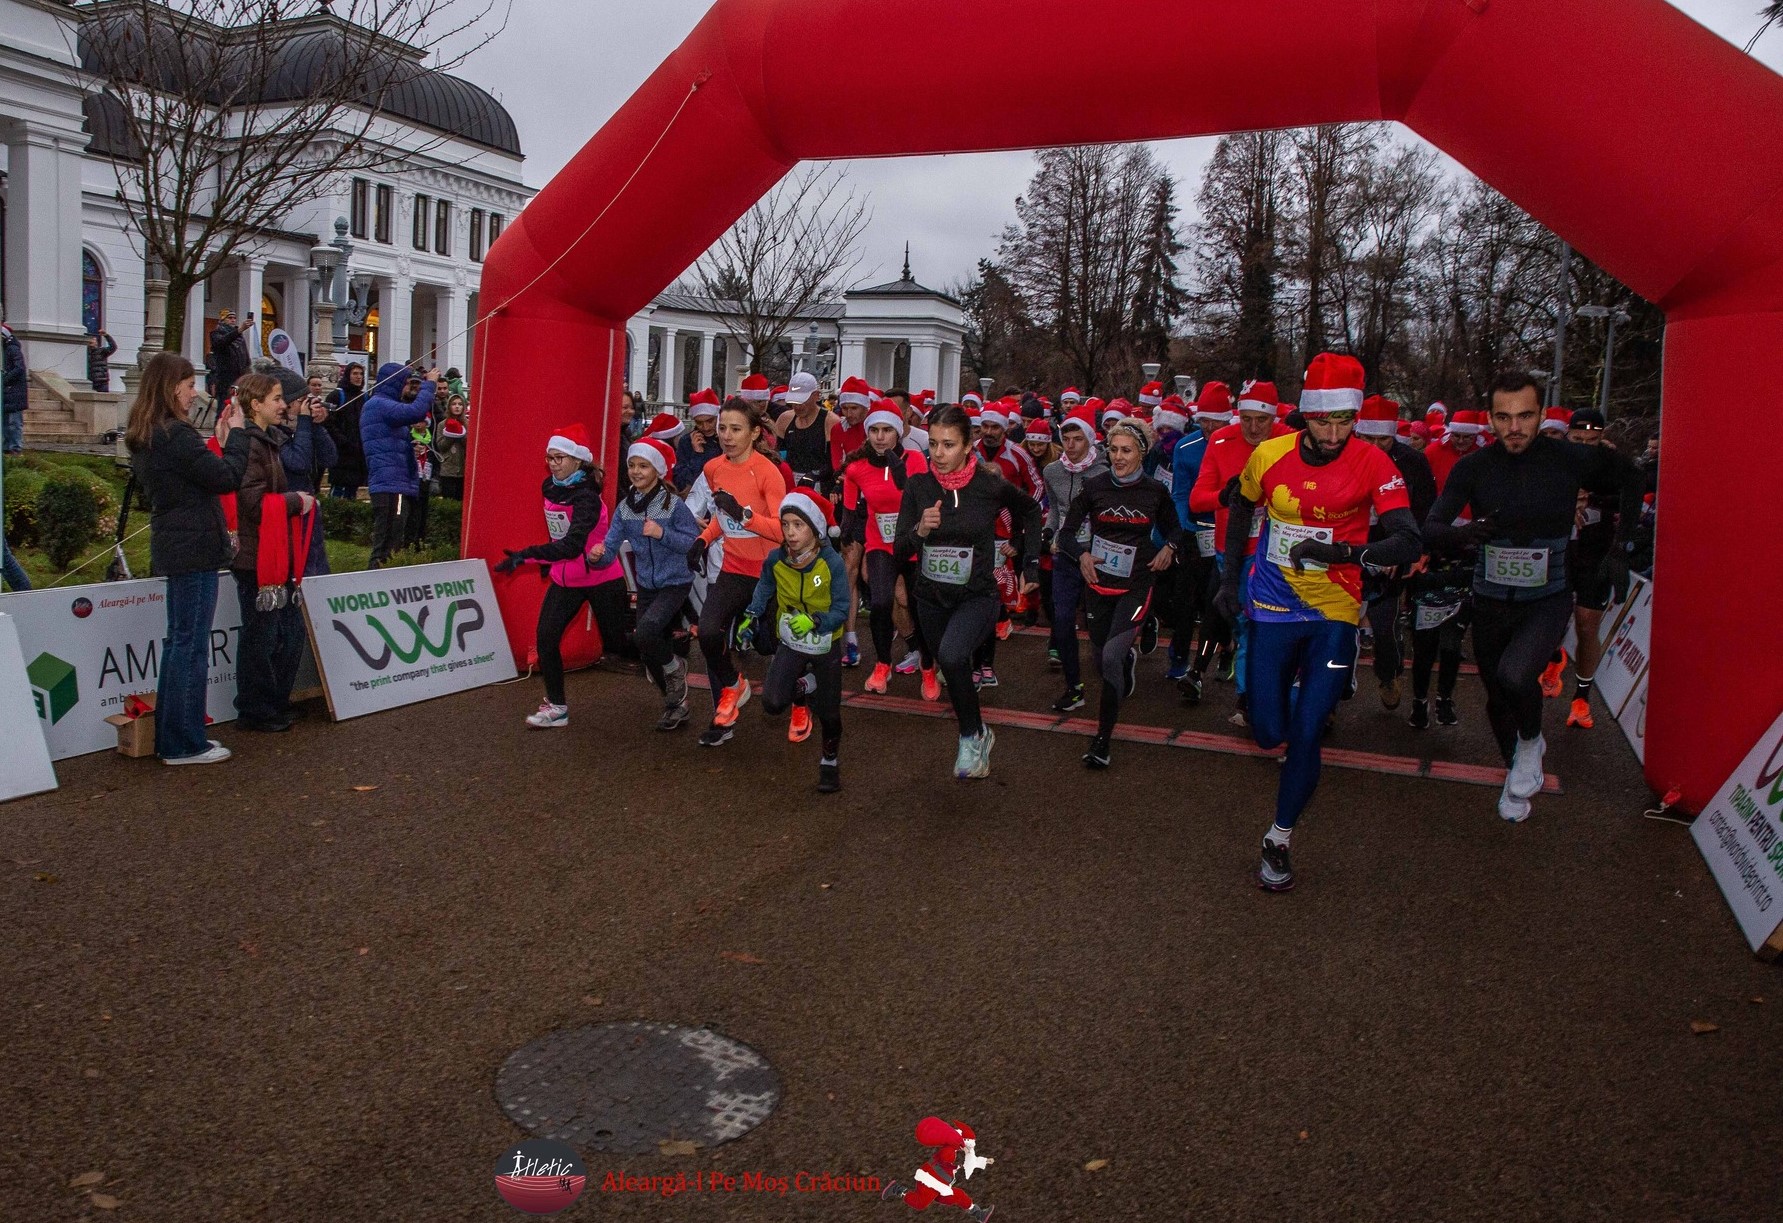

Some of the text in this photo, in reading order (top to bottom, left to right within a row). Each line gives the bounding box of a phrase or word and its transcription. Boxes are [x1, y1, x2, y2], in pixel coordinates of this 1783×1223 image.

[927, 559, 960, 575] 564
[1496, 560, 1534, 578] 555
[327, 578, 475, 614] WORLD WIDE PRINT
[370, 675, 392, 690] print
[392, 667, 430, 684] company
[430, 663, 448, 675] that
[447, 658, 468, 673] gives
[467, 659, 473, 667] a
[1745, 809, 1780, 854] PENTRU
